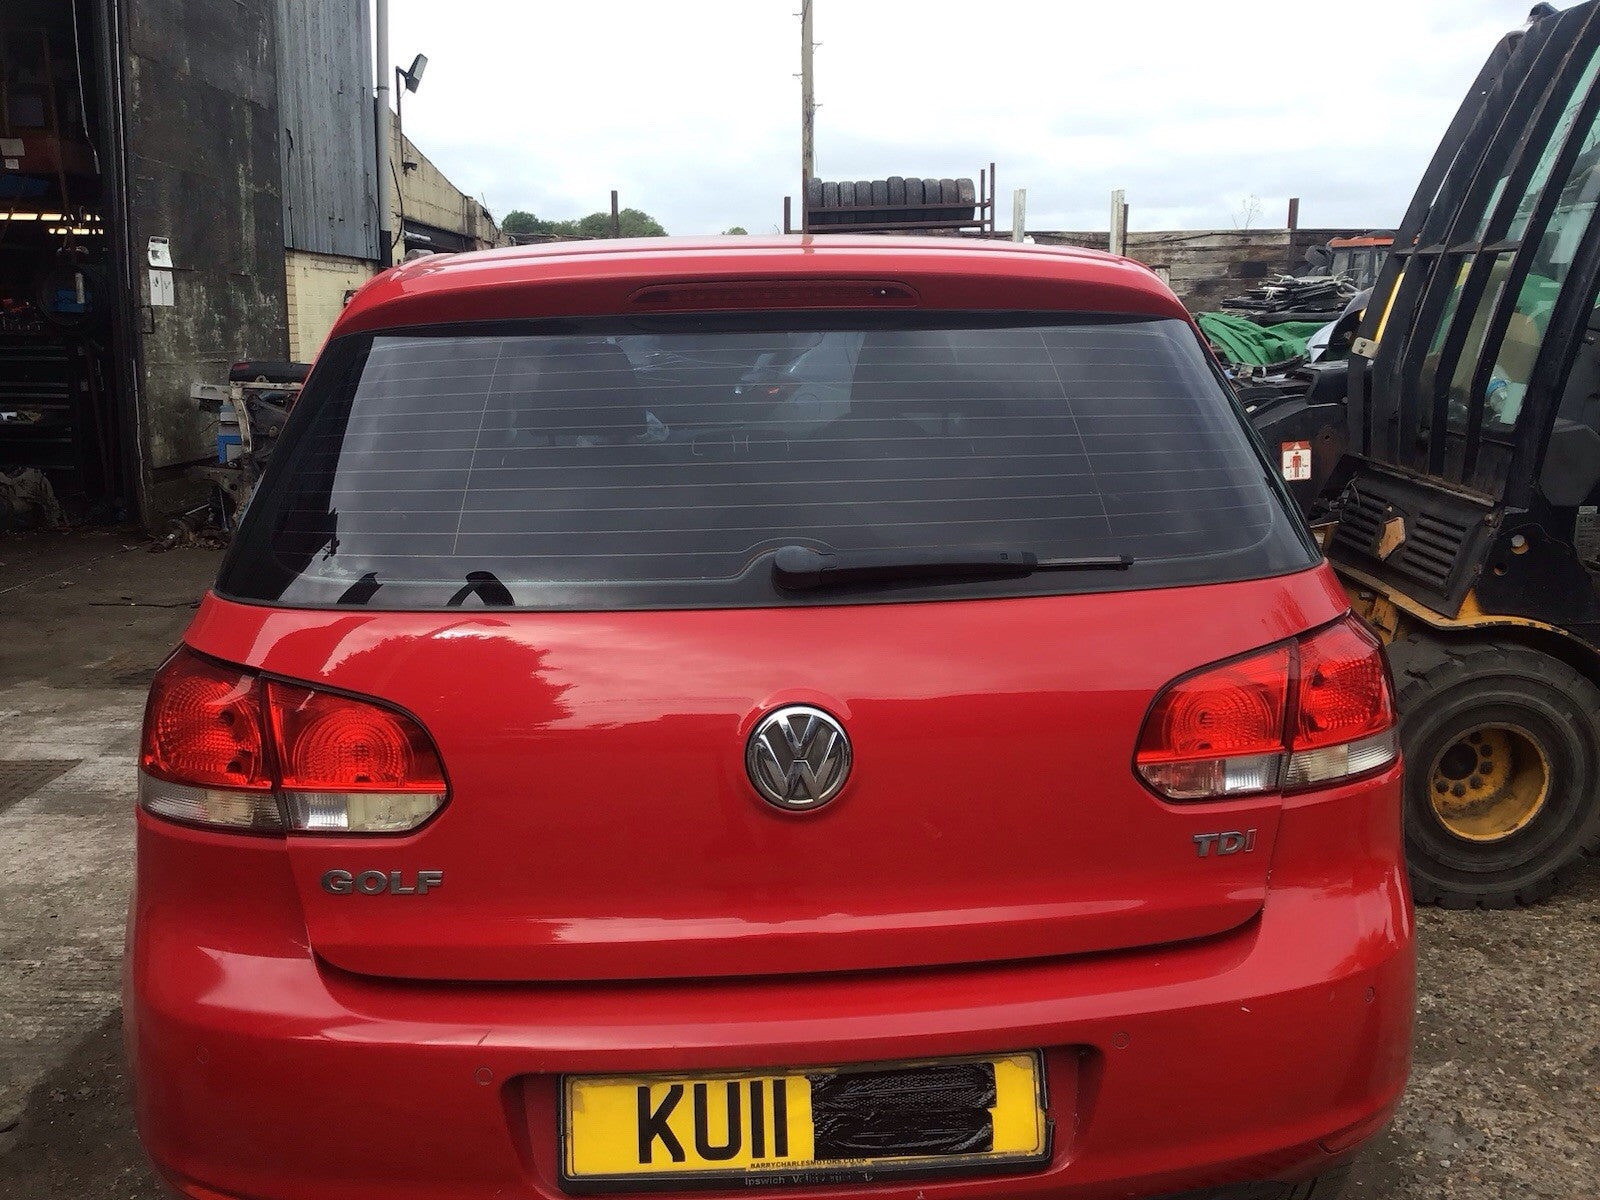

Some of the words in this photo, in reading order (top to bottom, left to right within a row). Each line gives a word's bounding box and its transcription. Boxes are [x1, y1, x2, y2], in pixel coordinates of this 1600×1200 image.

[1193, 828, 1257, 858] TDI
[320, 869, 443, 894] GOLF
[745, 1175, 786, 1186] Ipswich
